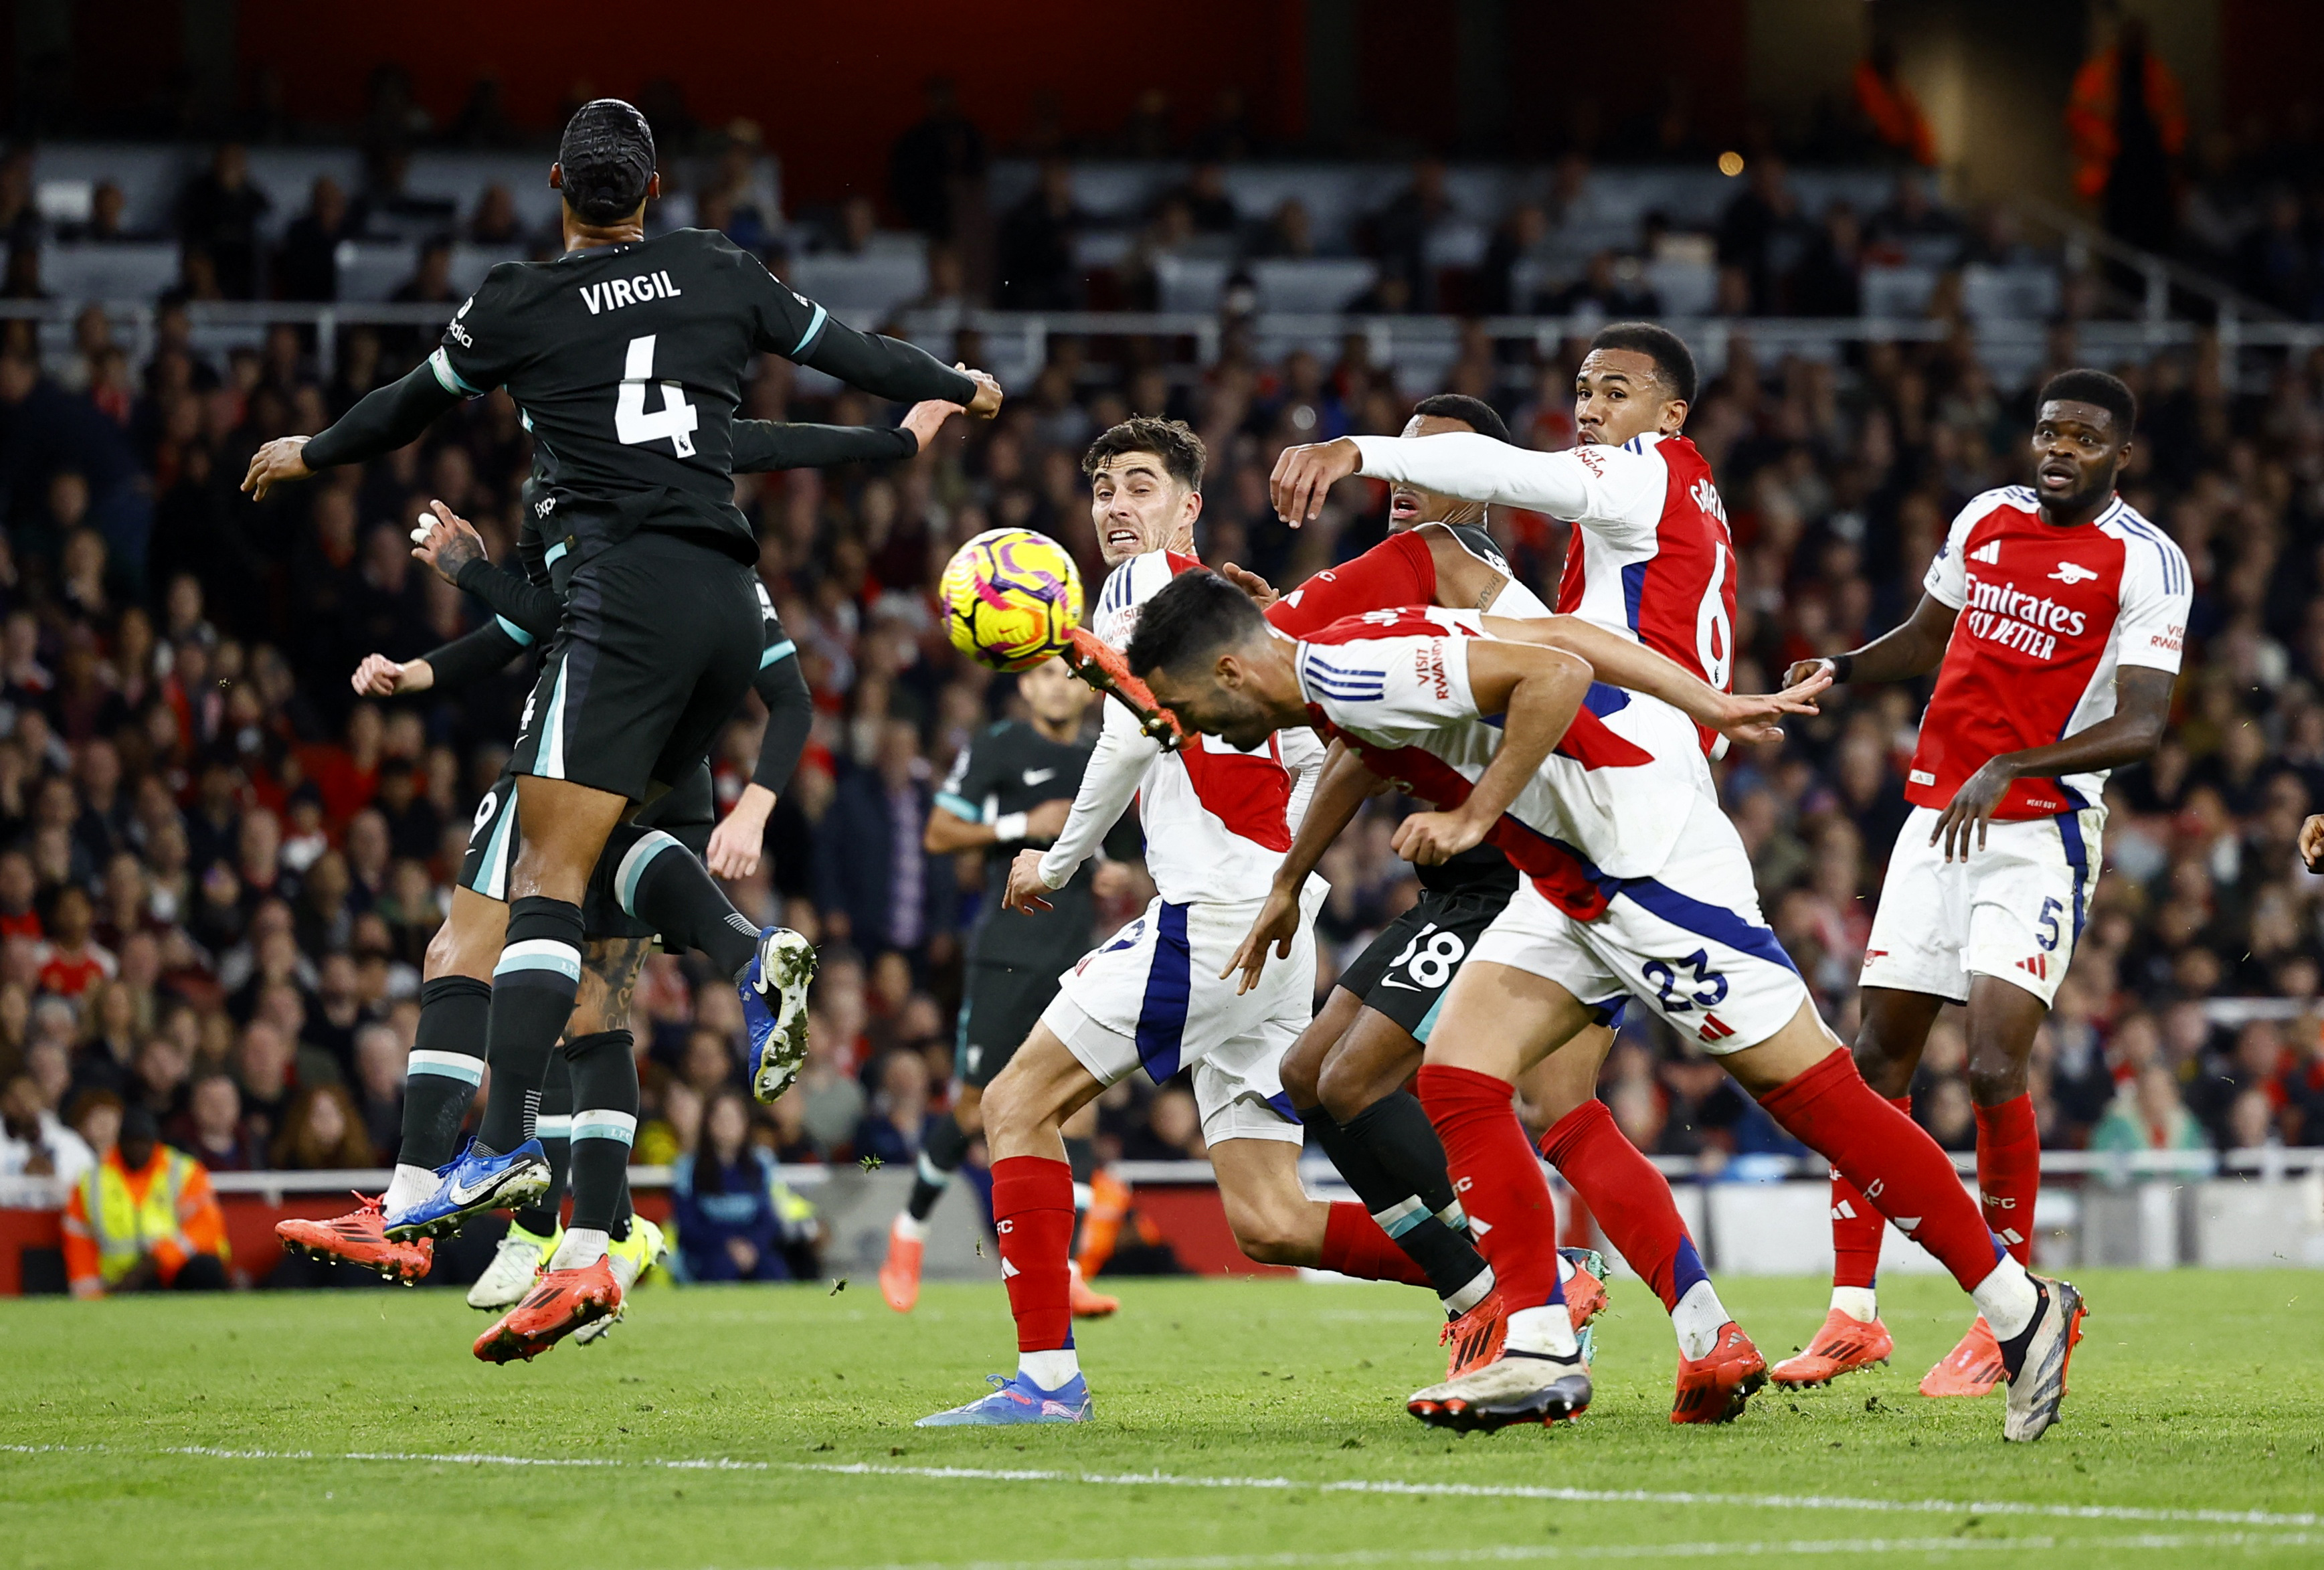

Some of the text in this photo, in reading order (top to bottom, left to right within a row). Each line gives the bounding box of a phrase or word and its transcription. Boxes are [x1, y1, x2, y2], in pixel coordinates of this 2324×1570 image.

[579, 270, 681, 315] VIRGIL
[615, 334, 697, 458] 4
[1696, 540, 1732, 691] 6
[1965, 572, 2086, 636] Emirates
[1969, 610, 2056, 661] FLY BETTER
[1415, 648, 1430, 687] VISIT
[2035, 896, 2063, 951] 5
[1641, 948, 1728, 1012] 23
